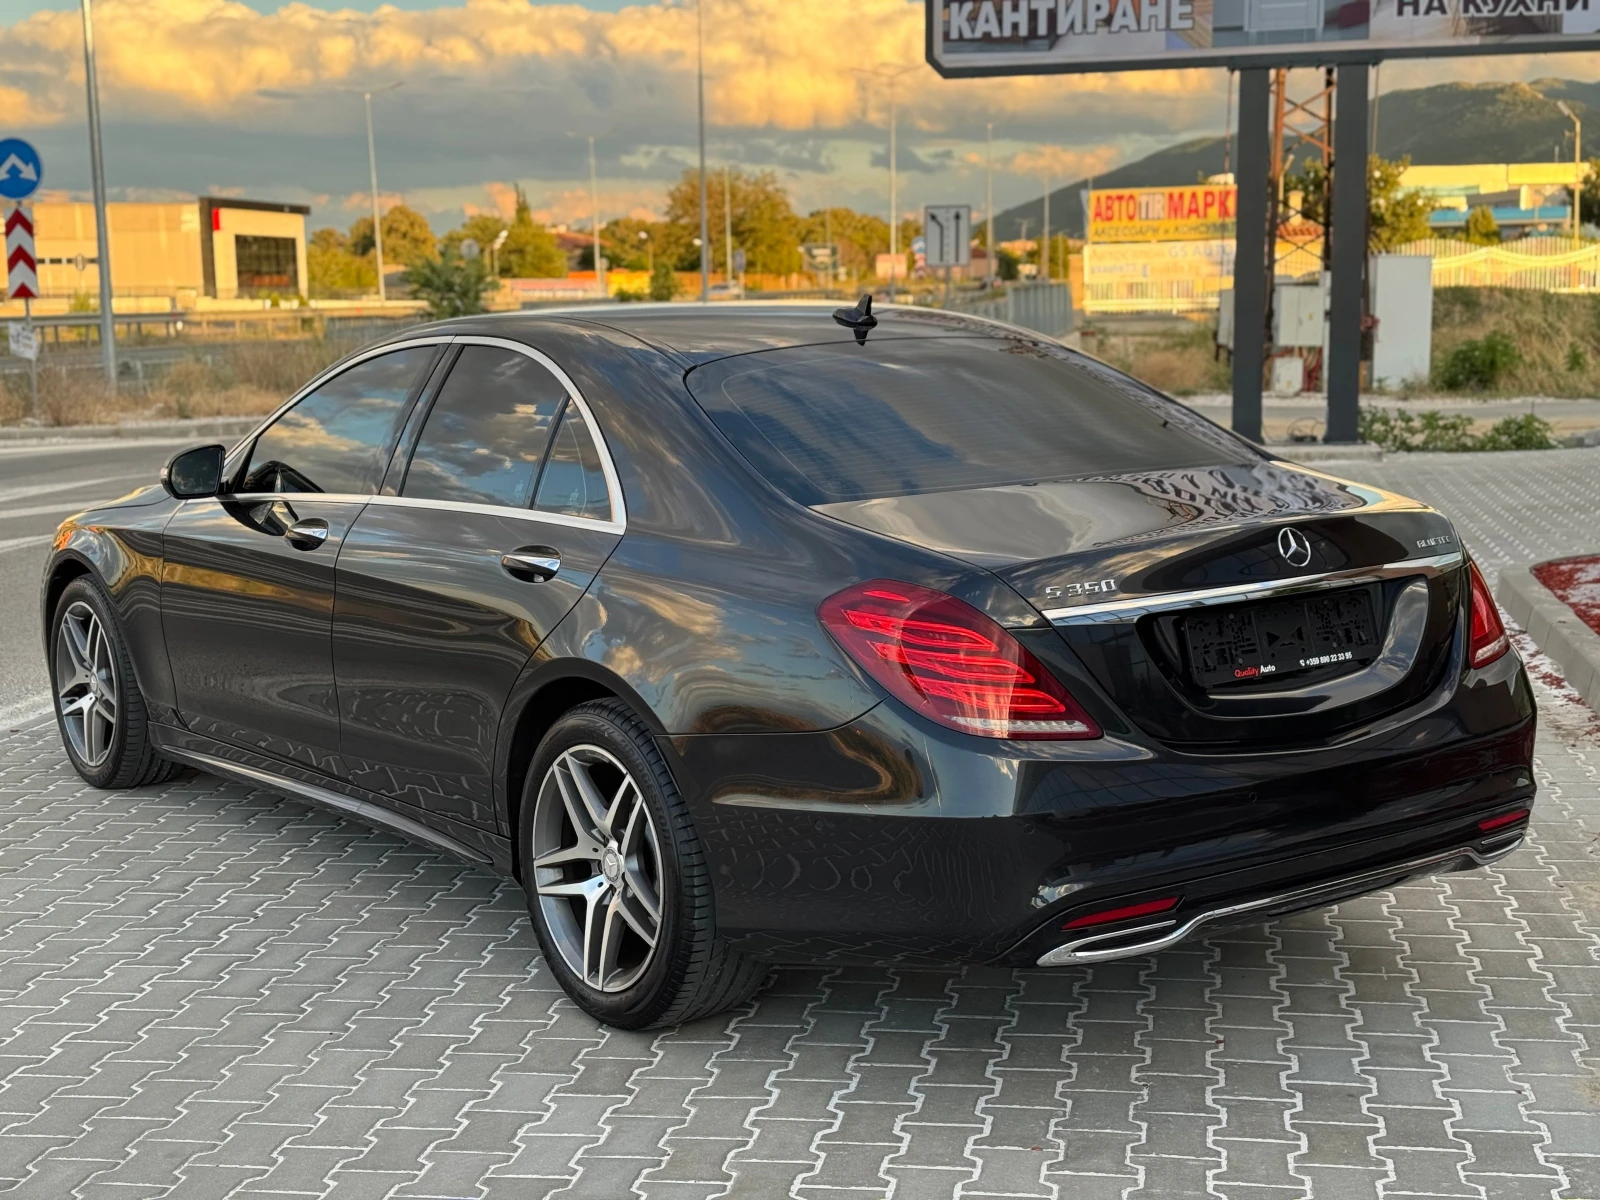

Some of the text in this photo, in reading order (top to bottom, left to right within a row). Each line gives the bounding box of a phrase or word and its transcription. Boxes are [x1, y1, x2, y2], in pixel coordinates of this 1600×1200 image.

[949, 0, 1194, 40] КАНТИРАНЕ
[1167, 190, 1237, 219] МАРК
[1045, 579, 1117, 600] S 350
[1330, 653, 1338, 662] 22
[1234, 664, 1276, 678] Quality Auto
